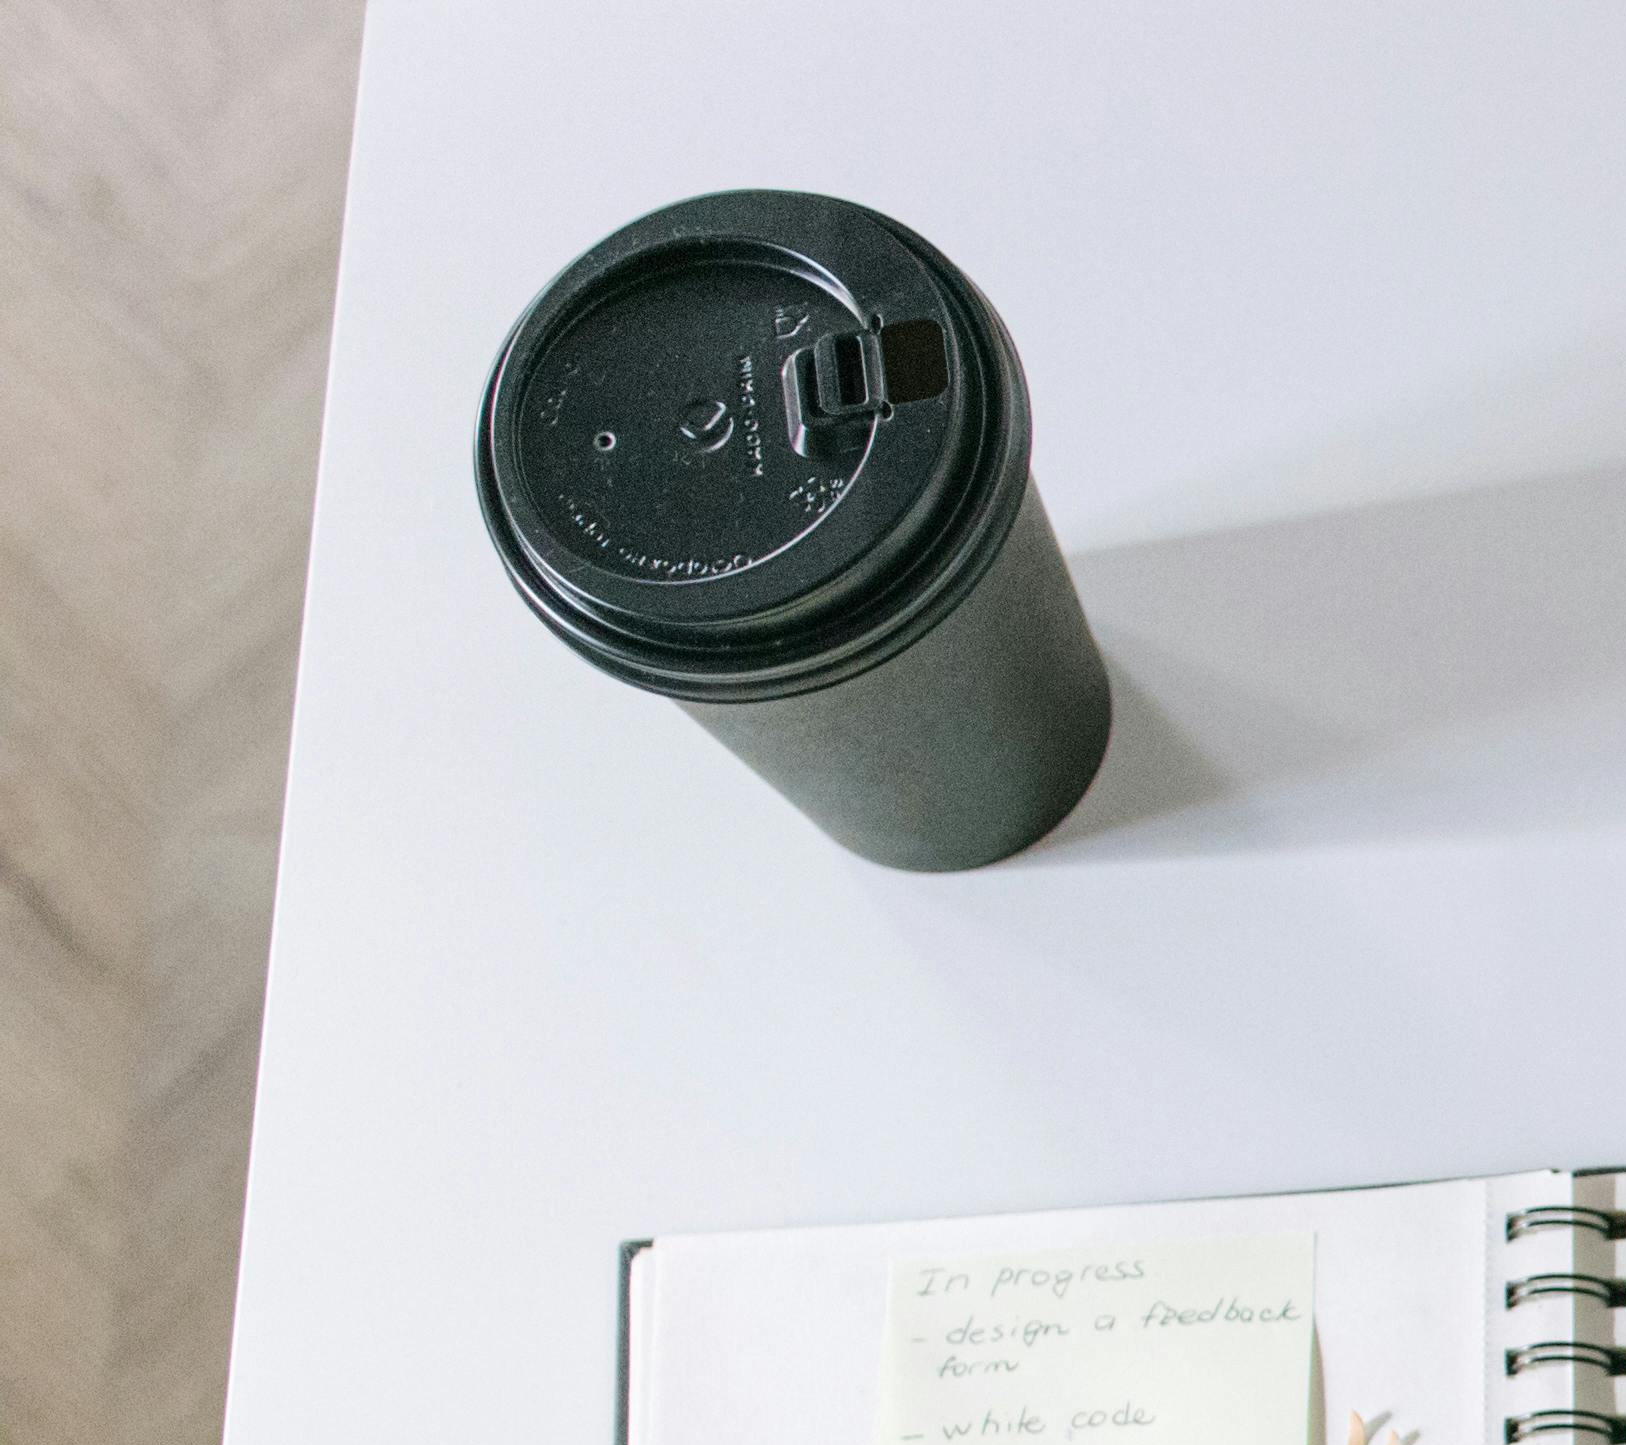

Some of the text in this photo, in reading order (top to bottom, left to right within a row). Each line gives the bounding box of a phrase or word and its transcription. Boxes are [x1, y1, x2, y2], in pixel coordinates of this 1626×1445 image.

[915, 1257, 1145, 1299] In progress
[945, 1297, 1302, 1347] design a feedback
[938, 1355, 1020, 1380] form
[1071, 1401, 1157, 1431] code
